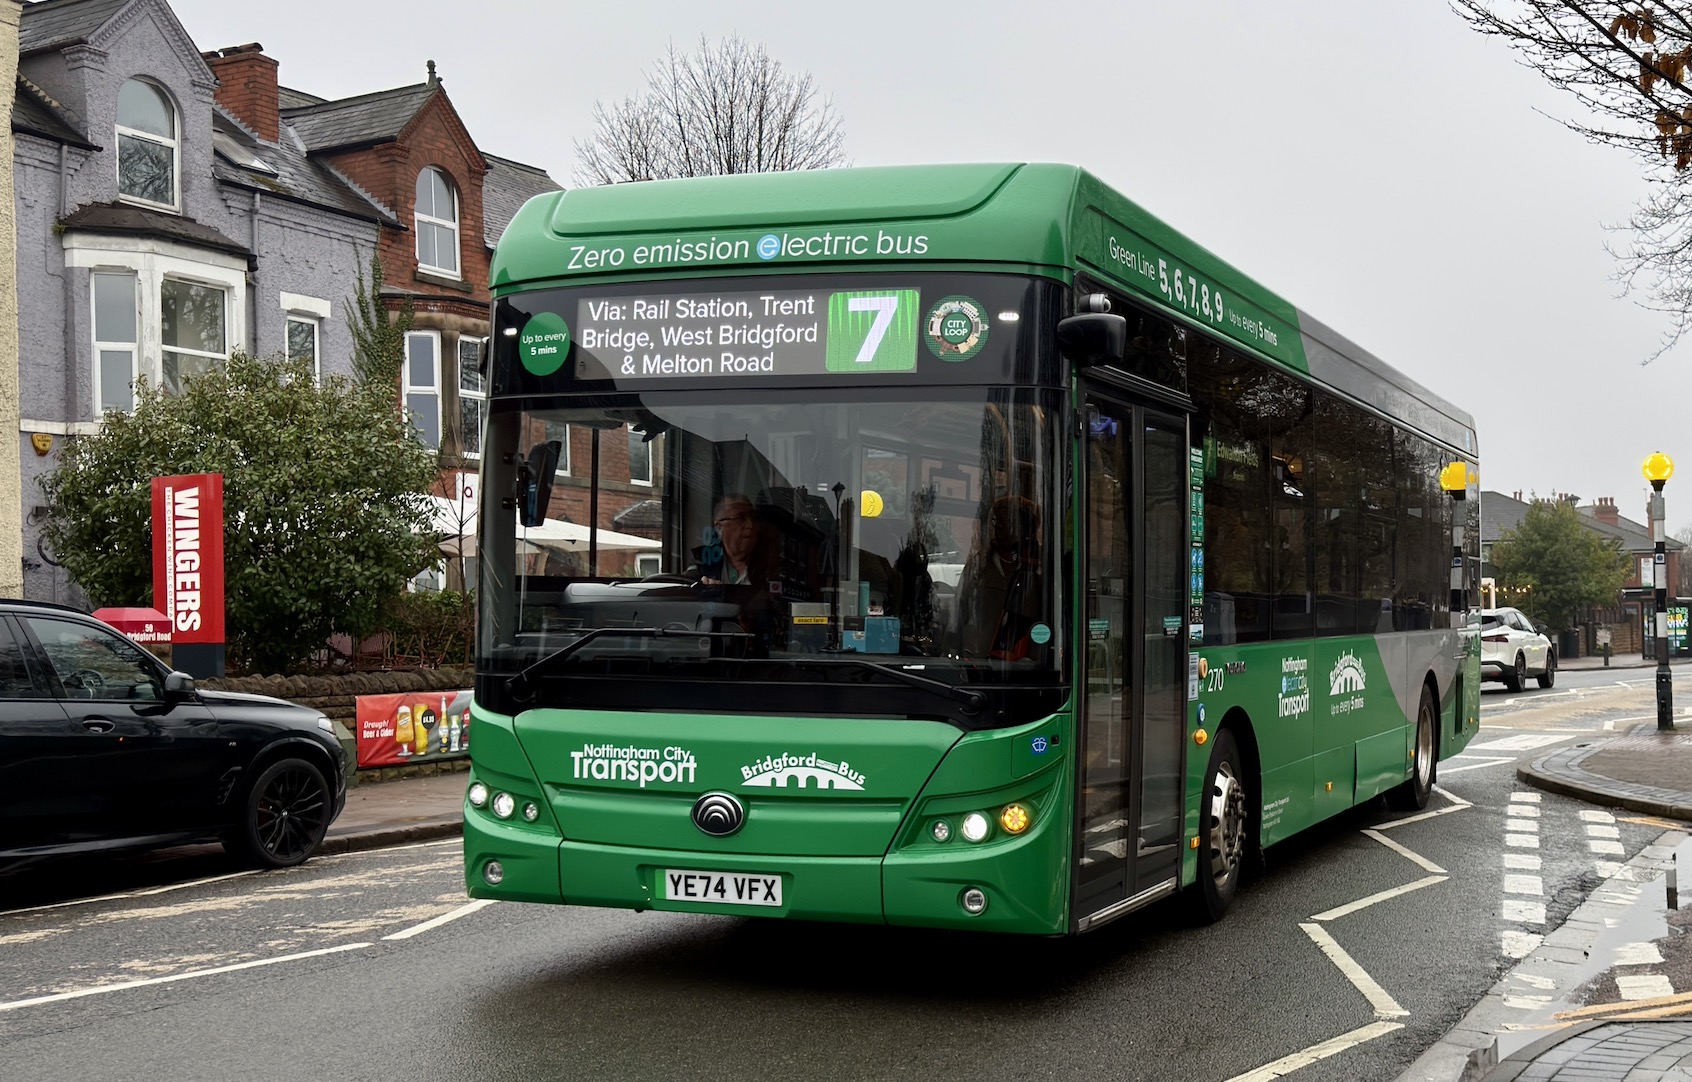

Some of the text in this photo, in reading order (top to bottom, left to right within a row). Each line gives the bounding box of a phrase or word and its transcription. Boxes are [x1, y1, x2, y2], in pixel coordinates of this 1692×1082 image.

[567, 230, 928, 269] Zero emission electric bus
[1109, 236, 1137, 271] Green
[1138, 252, 1155, 281] Line
[588, 295, 815, 321] Via: Rail Station, Trent
[582, 322, 817, 352] Bridge, West Bridgford
[848, 296, 898, 362] 7
[945, 328, 968, 336] LOOP
[947, 320, 966, 328] CITY
[1242, 316, 1258, 340] every
[1258, 321, 1263, 338] 5
[1264, 326, 1277, 346] mins
[522, 332, 566, 345] Up to every
[530, 345, 557, 356] 5 mins
[620, 352, 774, 375] & Melton Road
[174, 486, 201, 632] WINGERS
[157, 632, 171, 641] Road
[1208, 668, 1224, 692] 270
[1278, 688, 1309, 719] Transport
[1340, 700, 1350, 714] every
[1350, 696, 1354, 710] 5
[363, 730, 375, 738] Beer
[380, 728, 394, 737] Cider
[584, 743, 690, 762] Nottingham City
[571, 751, 697, 788] Transport
[741, 752, 816, 780] Bridgford
[838, 761, 866, 785] Bus
[670, 874, 776, 902] YE74 VFX
